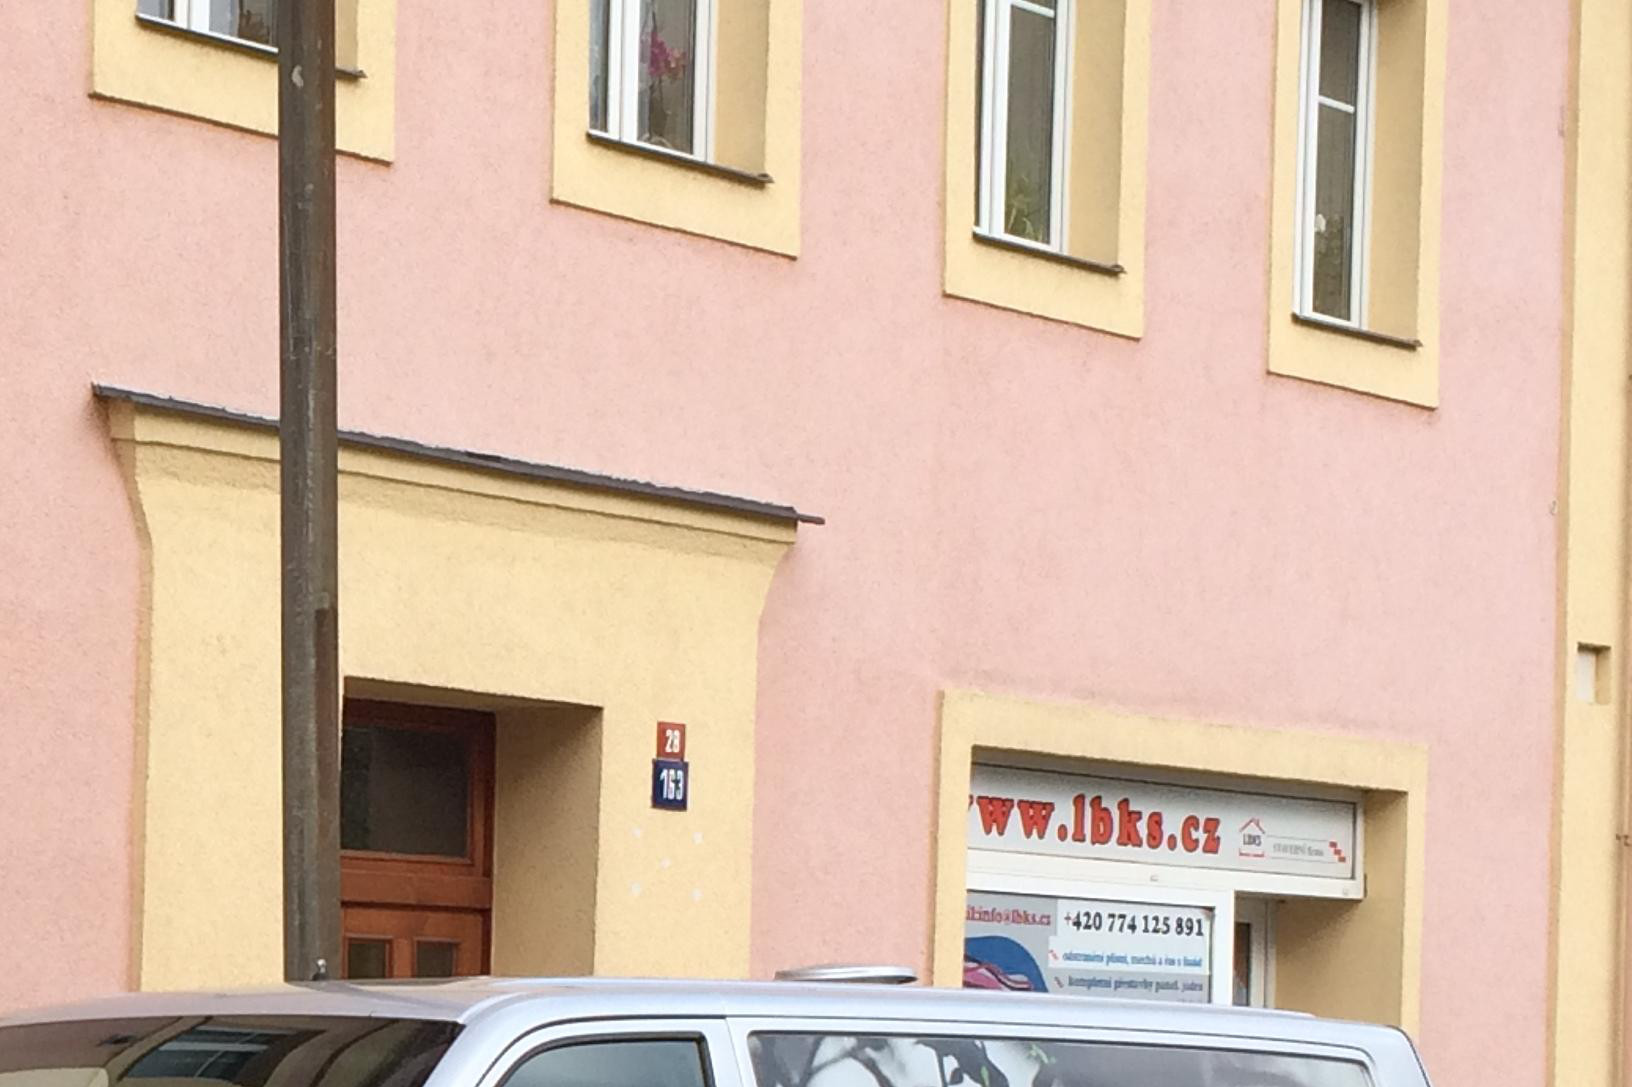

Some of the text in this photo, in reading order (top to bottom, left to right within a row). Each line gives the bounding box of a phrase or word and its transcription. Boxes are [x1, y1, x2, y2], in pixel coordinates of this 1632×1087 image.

[968, 793, 1221, 854] ww.lbks.cz
[1064, 911, 1204, 937] +420 774 125 891
